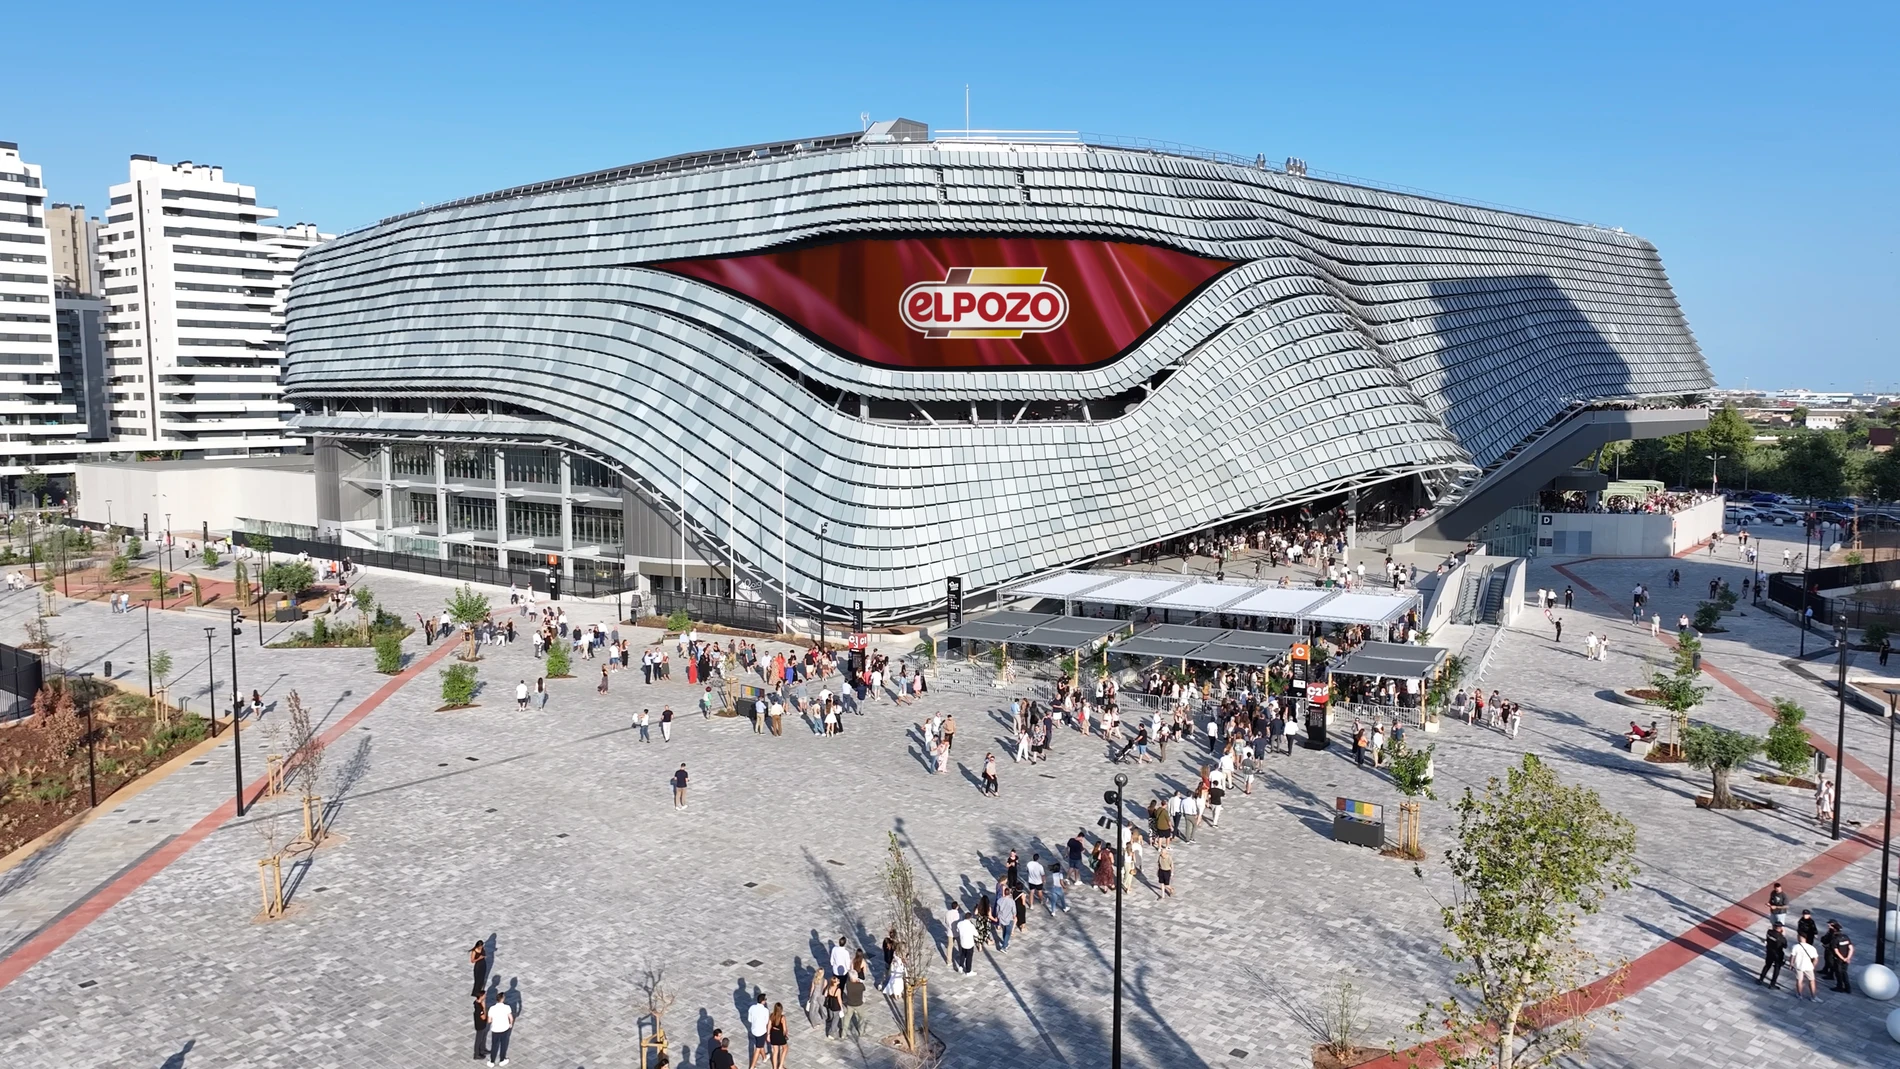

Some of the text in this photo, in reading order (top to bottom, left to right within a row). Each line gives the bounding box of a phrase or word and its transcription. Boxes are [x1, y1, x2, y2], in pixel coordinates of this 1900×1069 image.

[854, 602, 860, 610] B
[1296, 647, 1304, 657] C
[1307, 686, 1322, 696] C2
